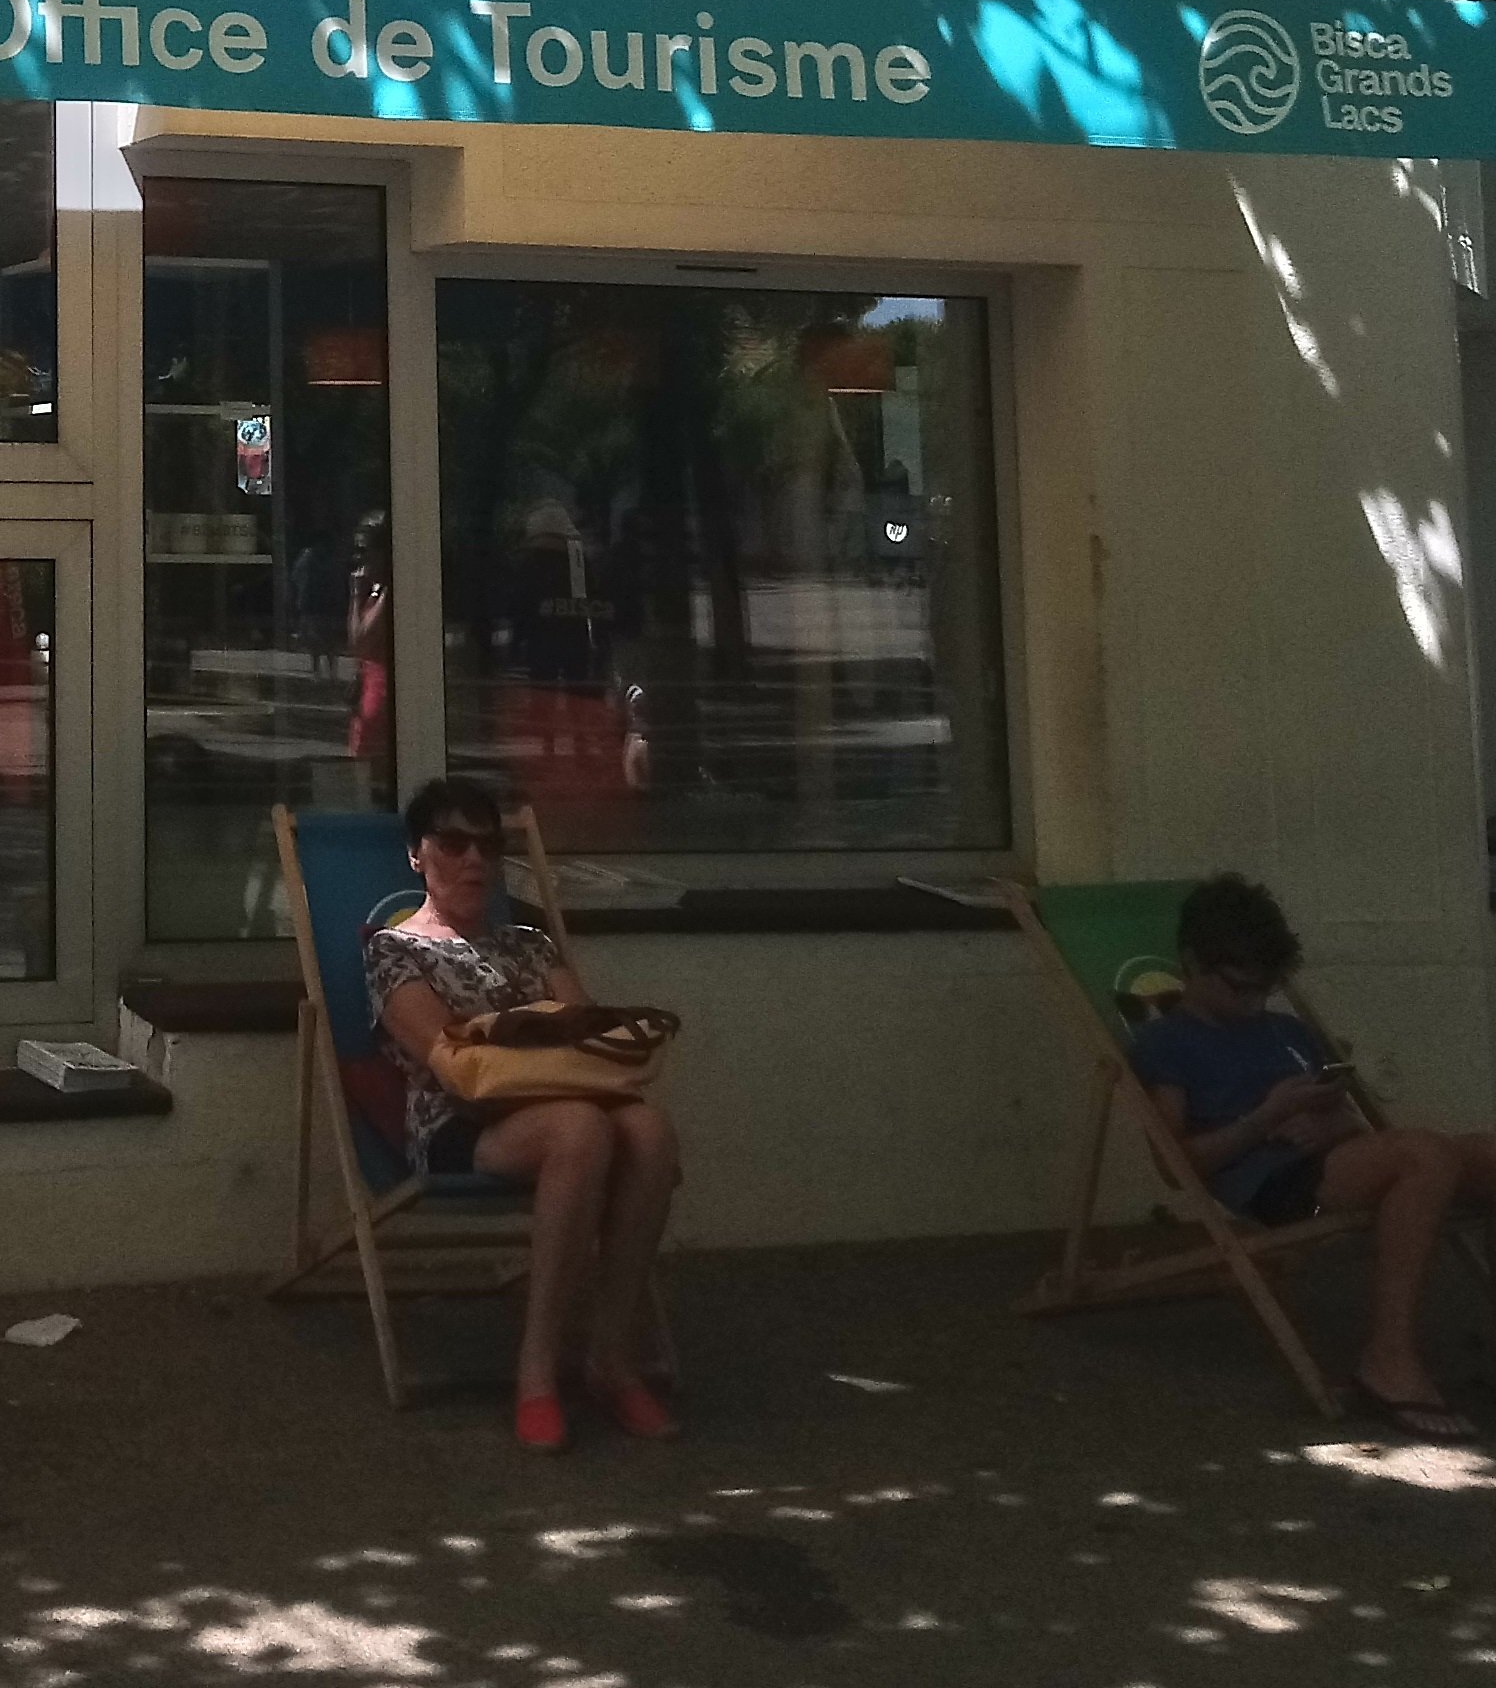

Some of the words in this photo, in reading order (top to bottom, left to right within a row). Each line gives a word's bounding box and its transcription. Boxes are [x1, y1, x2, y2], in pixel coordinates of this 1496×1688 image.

[470, 0, 932, 105] Tourisme
[1310, 19, 1411, 60] Bisca
[1315, 59, 1454, 98] Grands
[1321, 94, 1404, 134] Lacs
